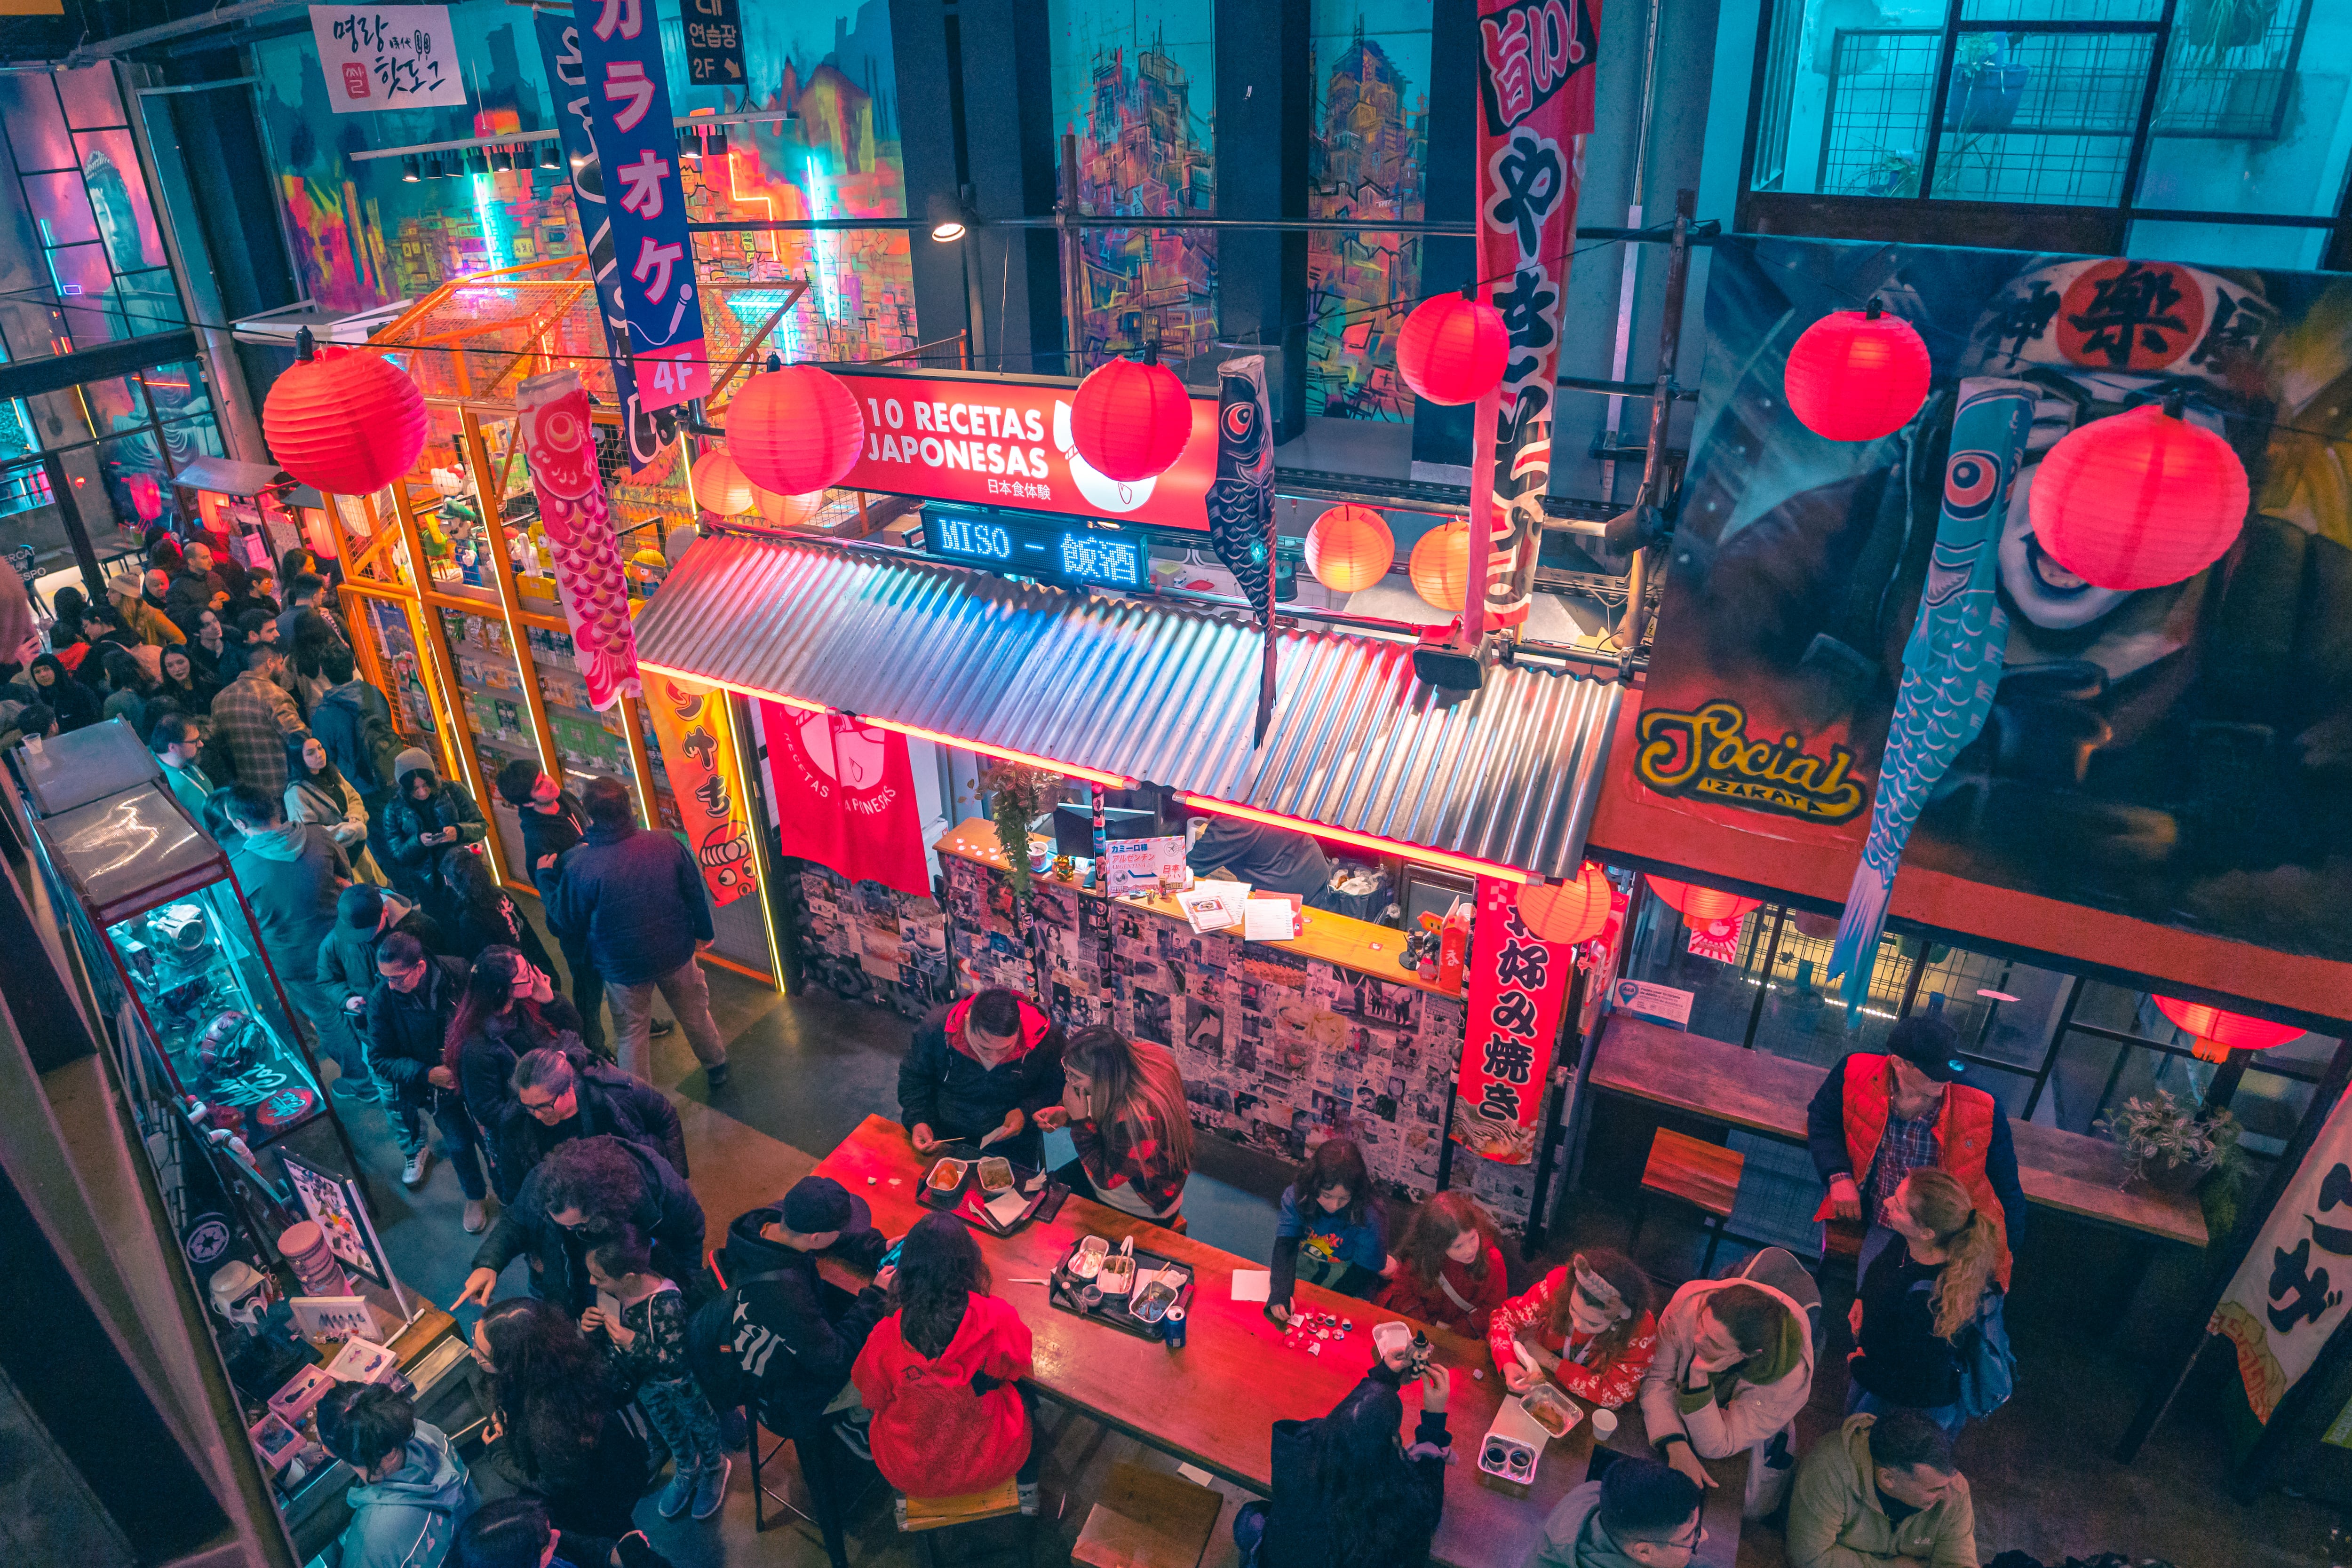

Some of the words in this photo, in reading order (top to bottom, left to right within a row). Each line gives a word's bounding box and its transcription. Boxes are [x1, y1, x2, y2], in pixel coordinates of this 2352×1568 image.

[334, 14, 389, 53] 명랑
[689, 23, 737, 48] 연습장
[374, 56, 446, 99] 핫도그
[694, 58, 715, 78] 2F
[592, 0, 684, 307] カラオケ
[653, 352, 694, 396] 4F
[868, 398, 903, 429] 10
[914, 400, 1045, 442] RECETAS
[868, 433, 1049, 479] JAPONESAS
[988, 479, 1051, 500] 日本食体験
[939, 519, 1009, 558] MISO
[1642, 704, 1860, 816] Social
[838, 785, 896, 815] APONESAS
[1112, 853, 1155, 864] アルゼンチン
[1163, 864, 1180, 874] 日本
[1478, 903, 1548, 1121] 好み焼き
